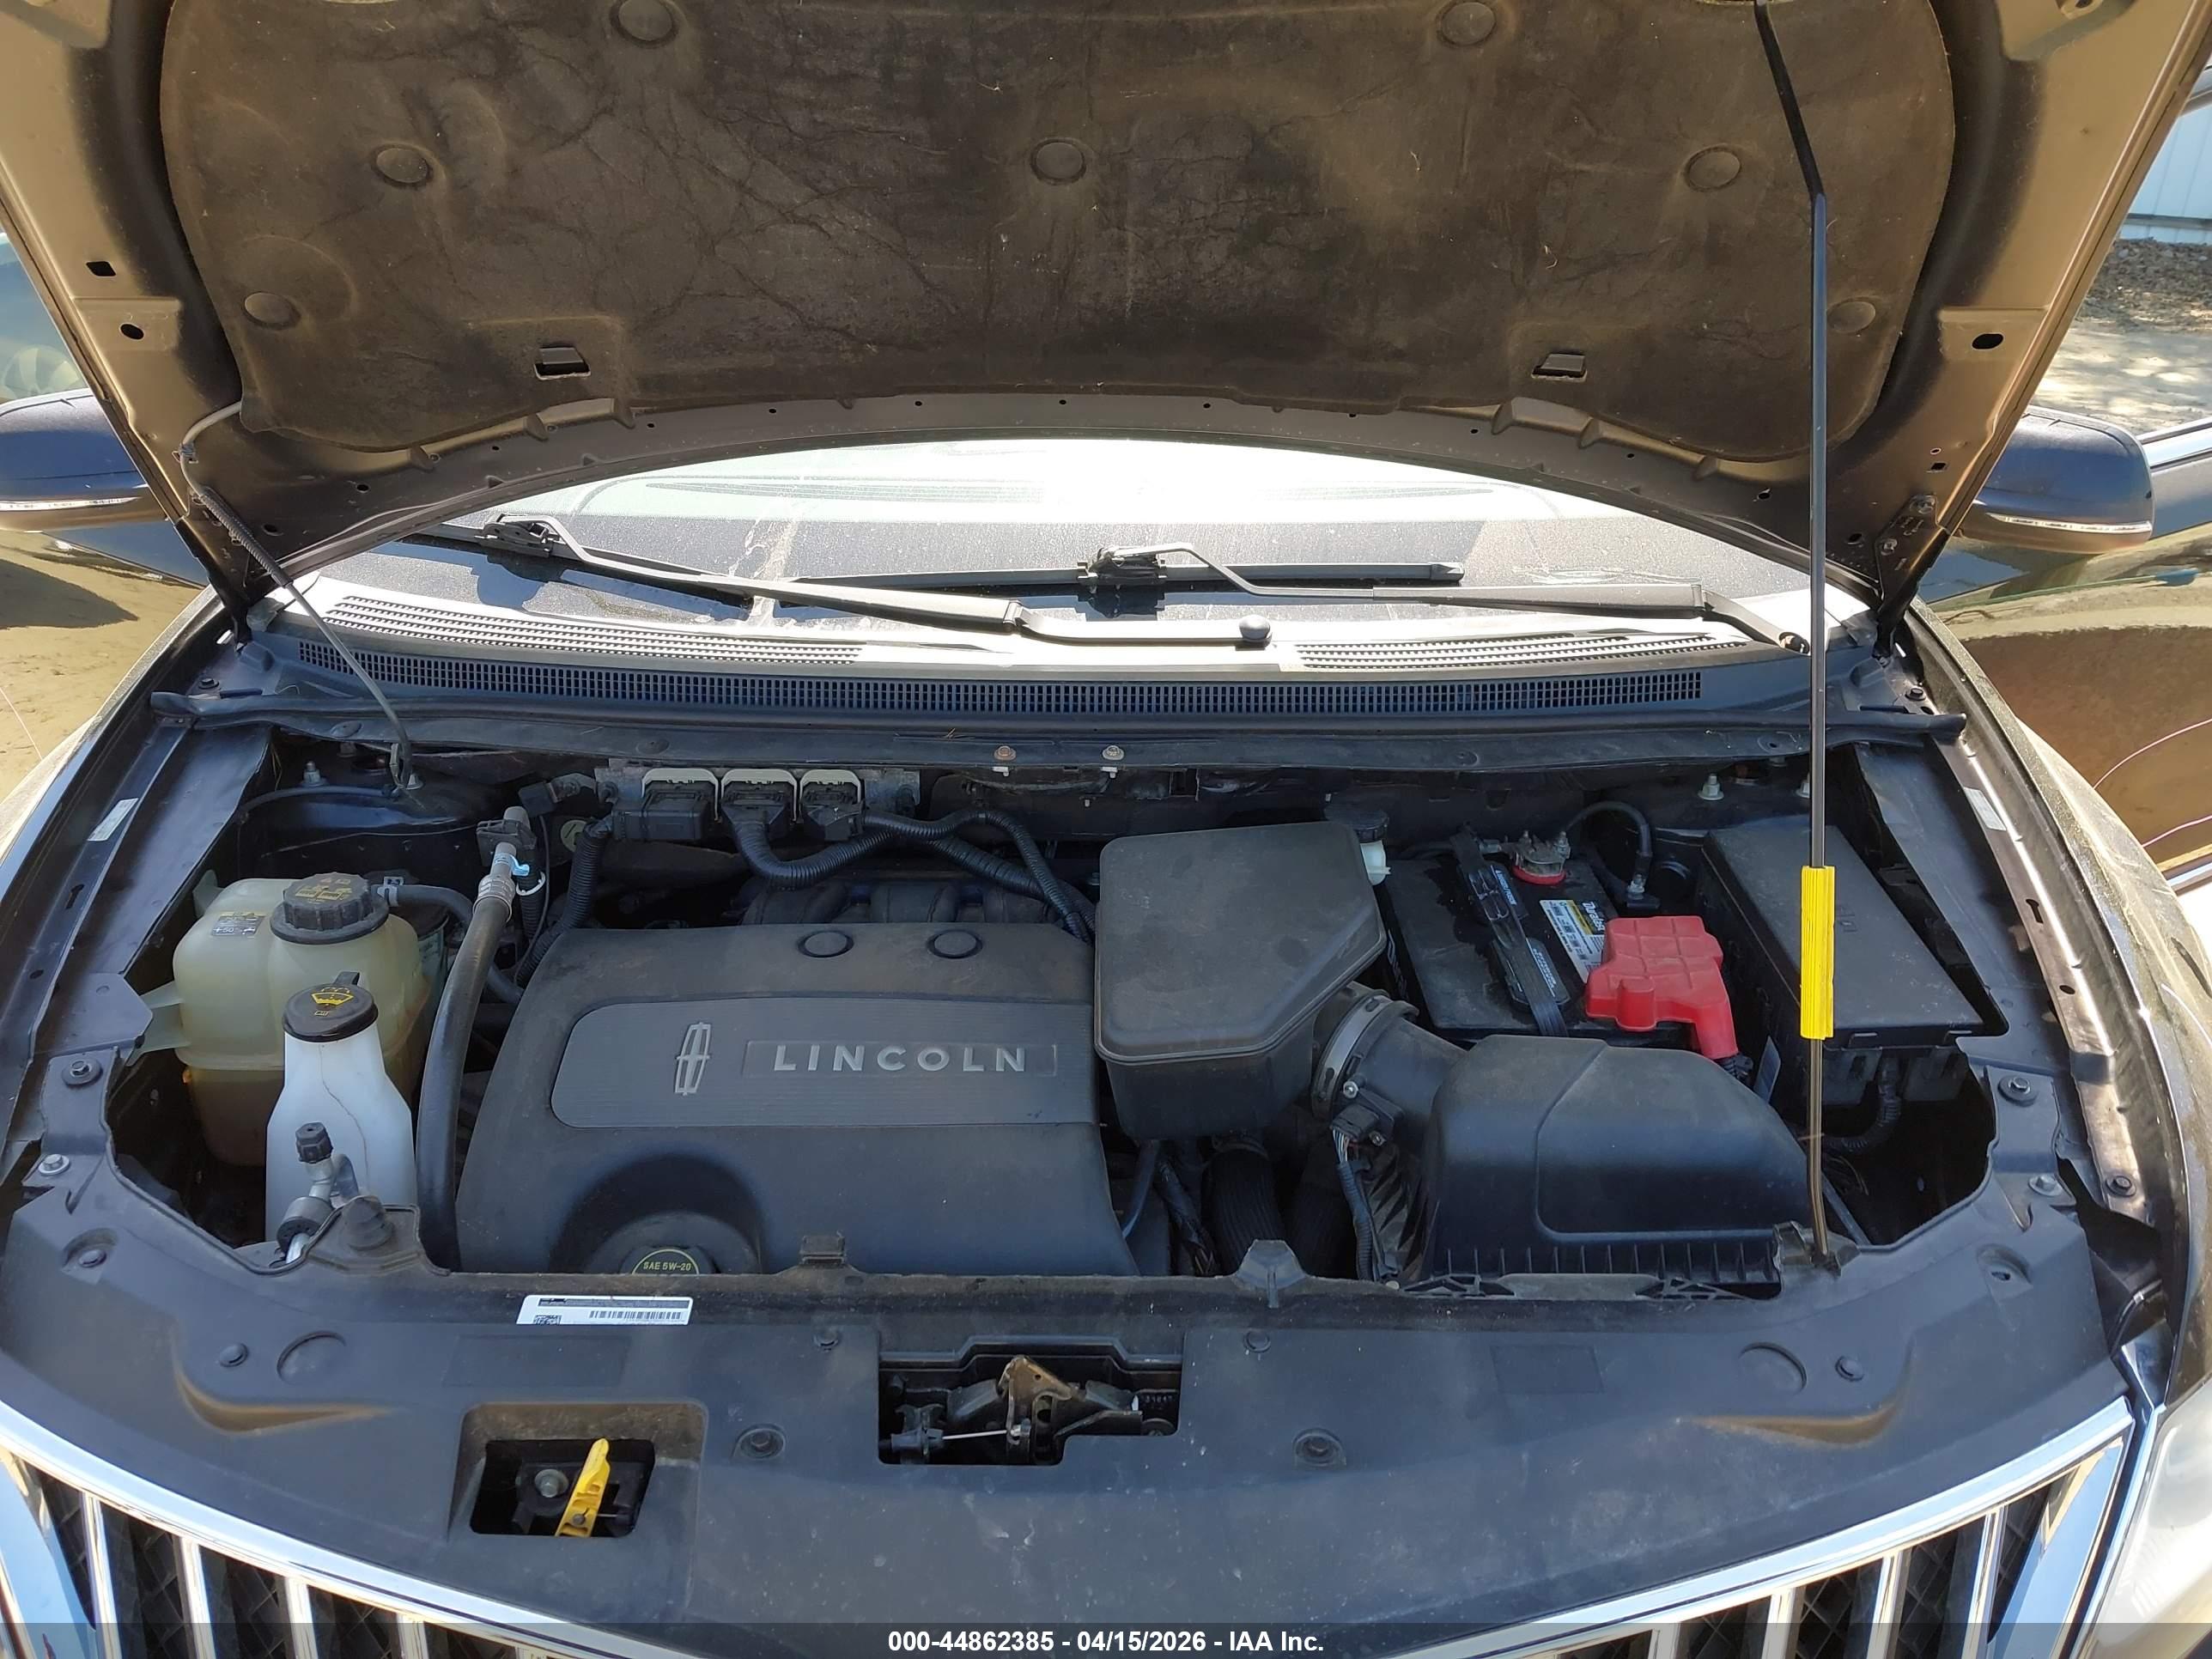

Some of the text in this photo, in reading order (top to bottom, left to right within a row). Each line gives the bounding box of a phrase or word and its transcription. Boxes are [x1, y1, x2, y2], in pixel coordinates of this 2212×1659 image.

[774, 1044, 1026, 1073] LINCOLN
[643, 1261, 692, 1272] SAE 5W-20
